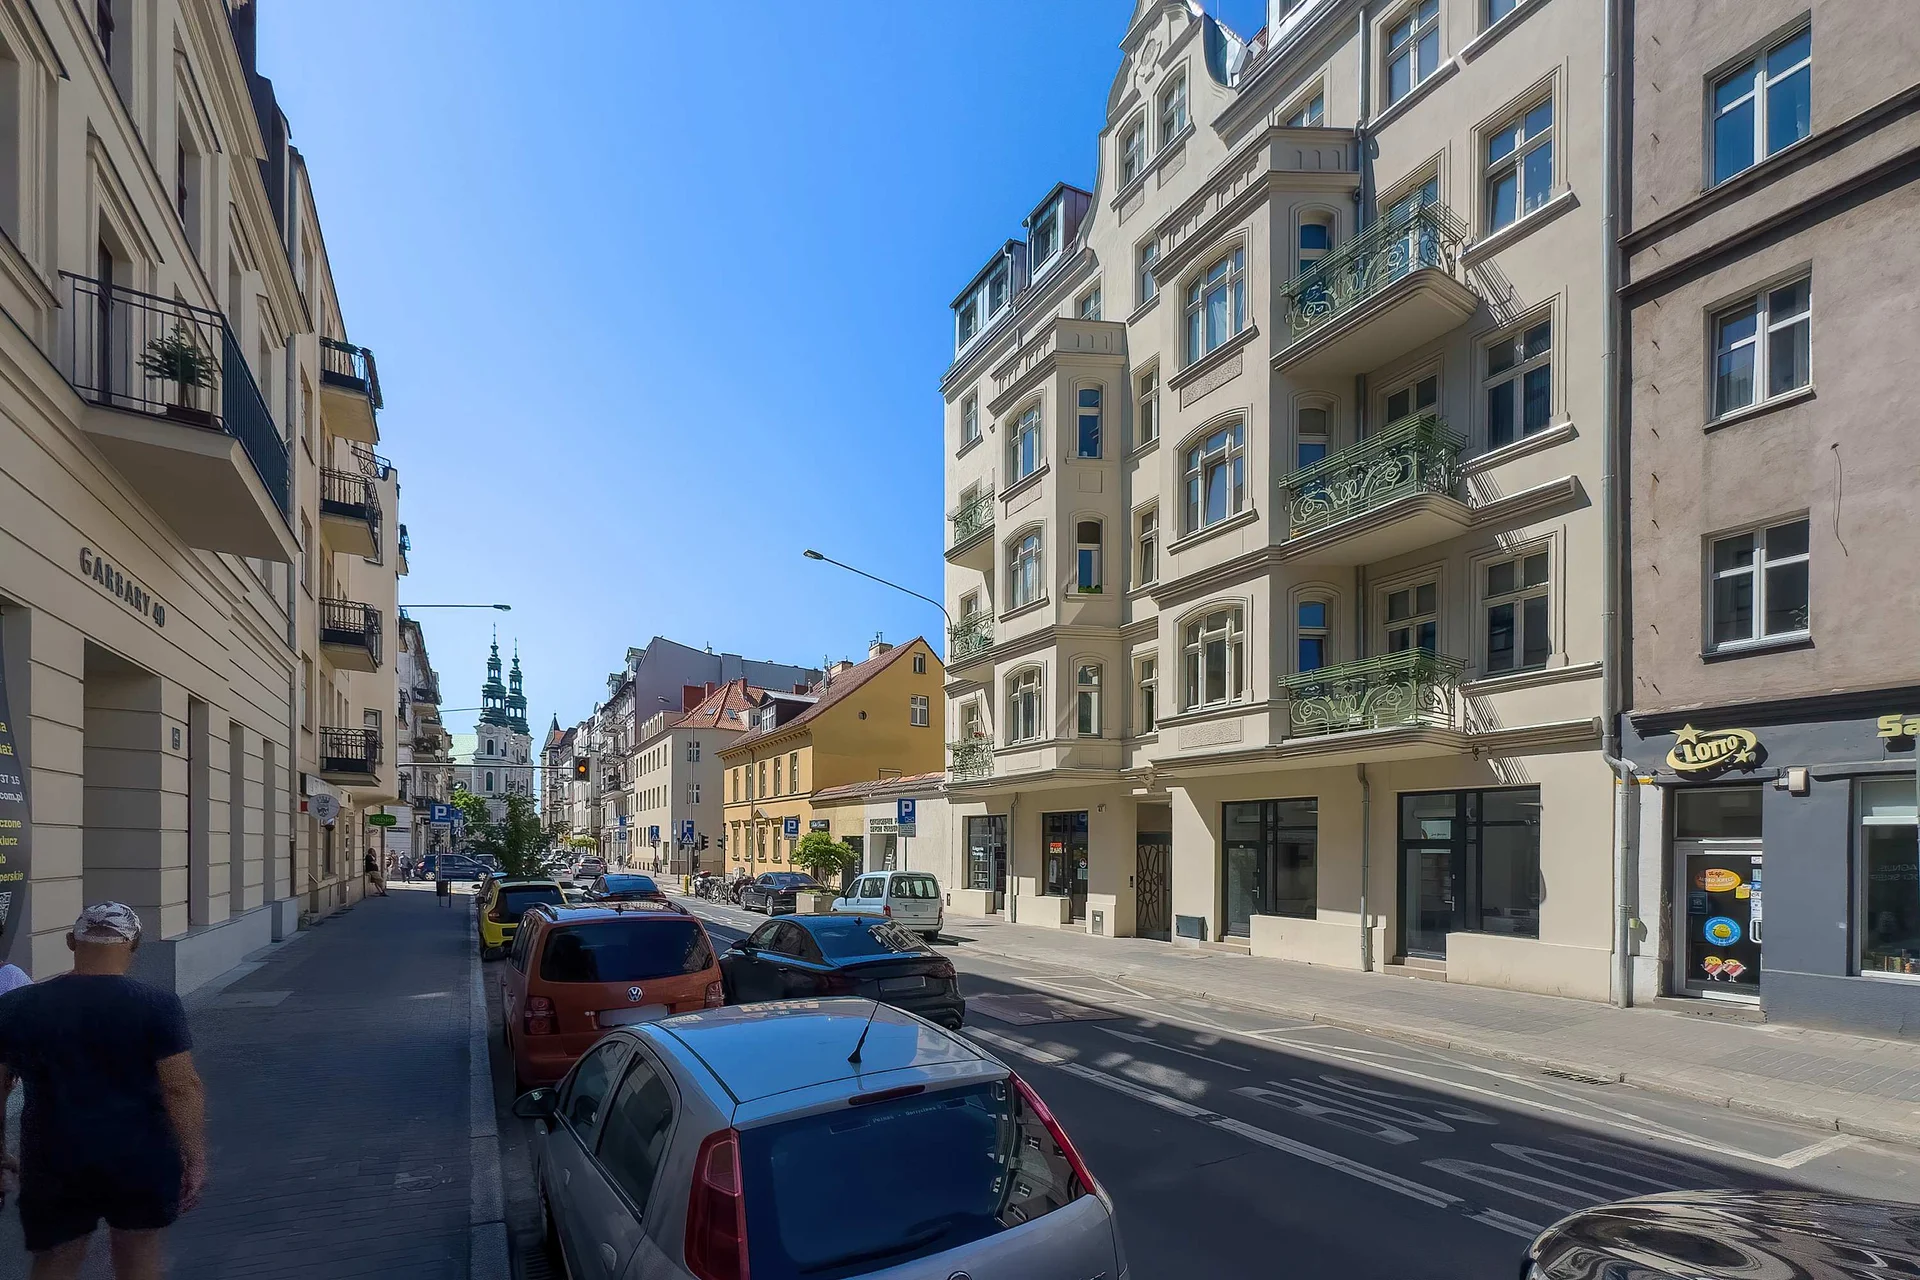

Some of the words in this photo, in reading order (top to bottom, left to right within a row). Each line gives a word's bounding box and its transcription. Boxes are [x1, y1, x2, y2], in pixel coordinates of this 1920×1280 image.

[79, 547, 151, 617] GARBARY
[152, 602, 166, 628] 40
[1876, 713, 1920, 738] Sa
[1682, 735, 1739, 763] LOTTO
[434, 805, 448, 820] P
[901, 800, 913, 817] P
[787, 820, 796, 832] P
